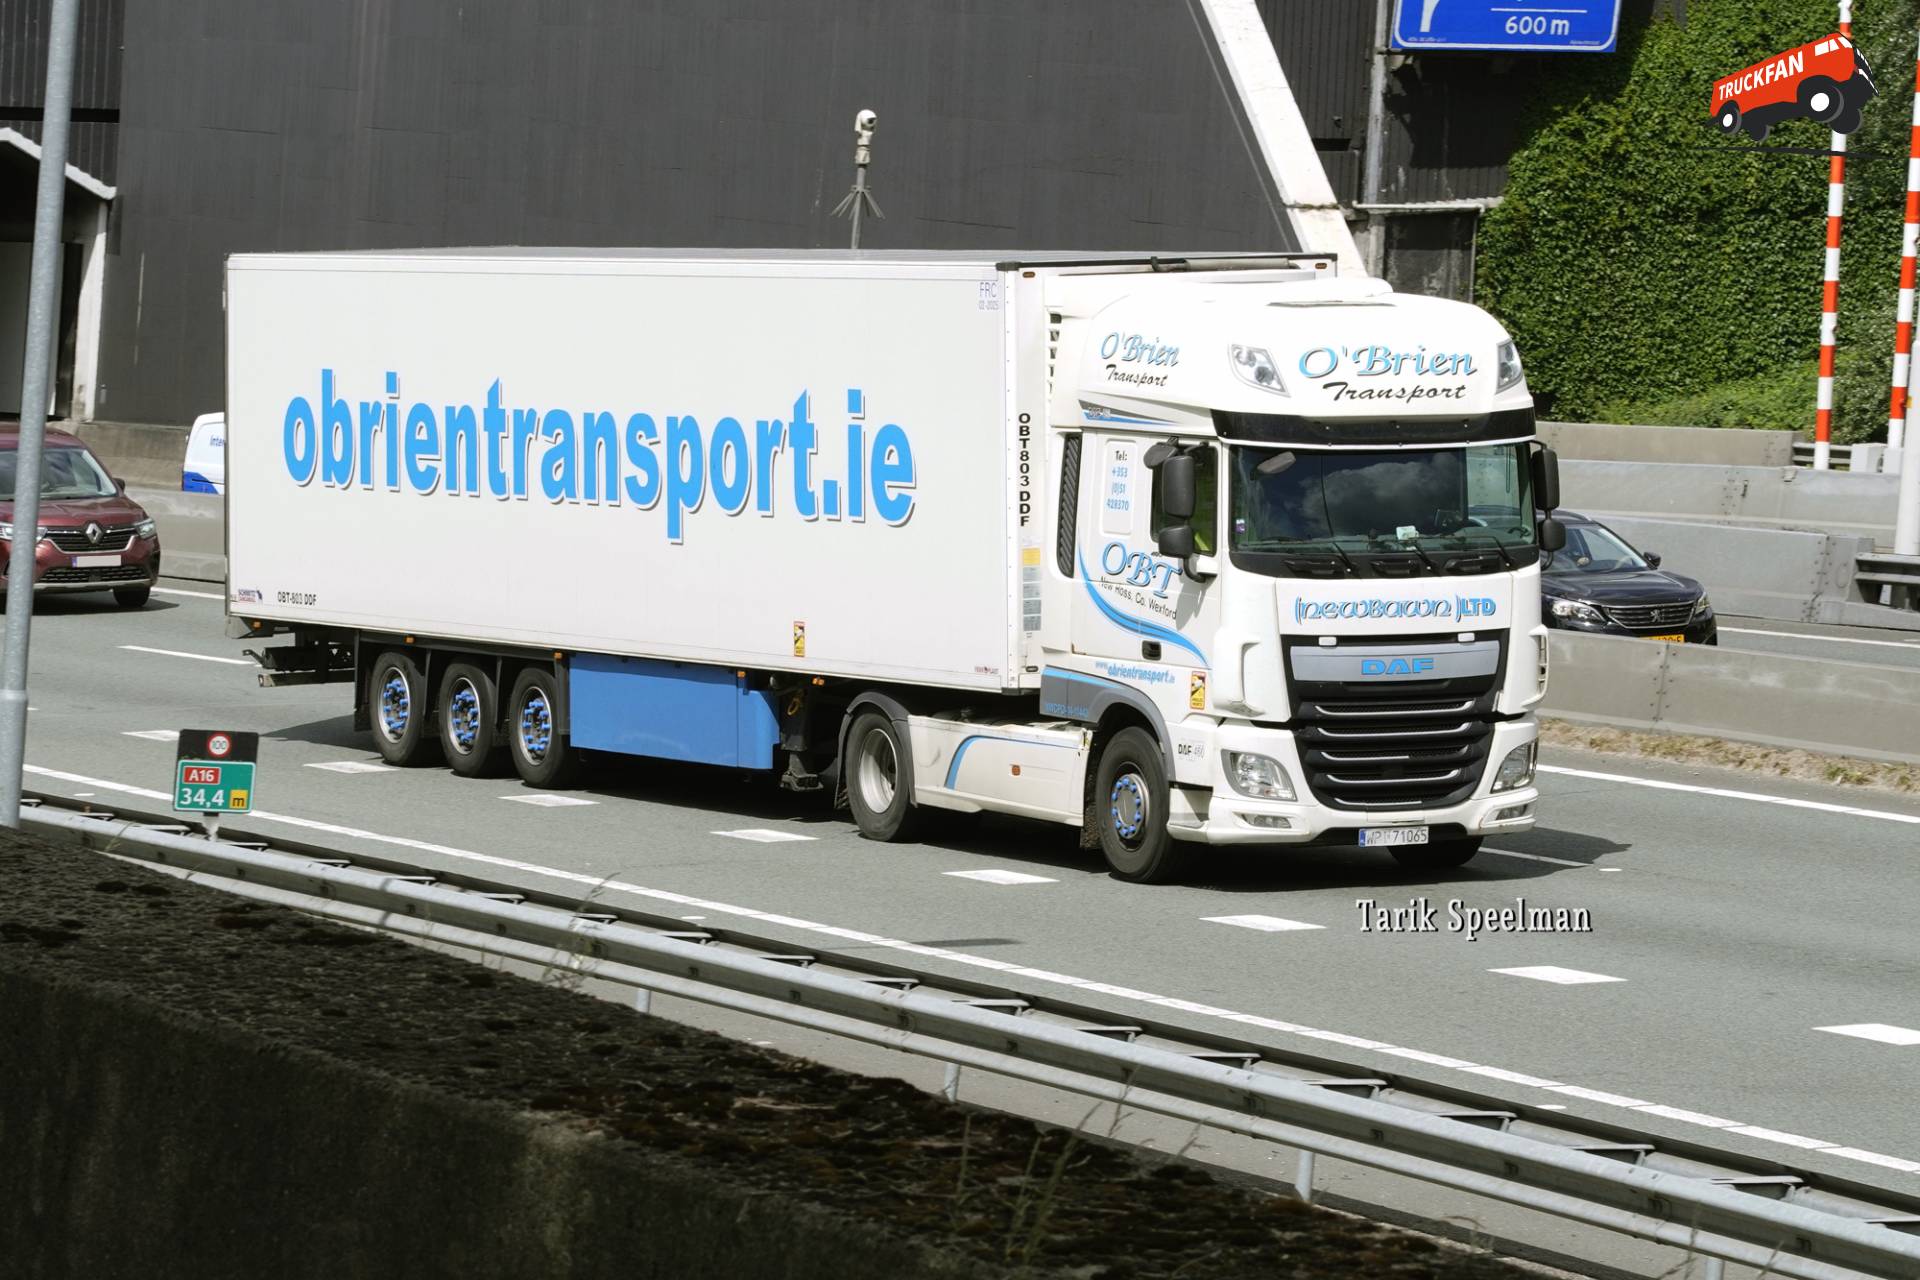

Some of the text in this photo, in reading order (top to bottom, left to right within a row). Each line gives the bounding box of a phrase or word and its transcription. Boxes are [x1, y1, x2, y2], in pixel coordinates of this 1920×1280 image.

[1505, 15, 1570, 36] 600 m
[979, 281, 998, 298] FRC
[1101, 332, 1180, 367] O'Brien
[1298, 345, 1478, 379] O'Brien
[1106, 363, 1168, 387] Transport
[1322, 381, 1467, 403] Transport
[283, 368, 917, 545] obrientransport.ie
[1102, 541, 1183, 600] OBT
[1149, 598, 1177, 620] Wexford
[1361, 658, 1435, 676] DAF
[188, 769, 215, 782] A16
[179, 788, 224, 808] 34,4
